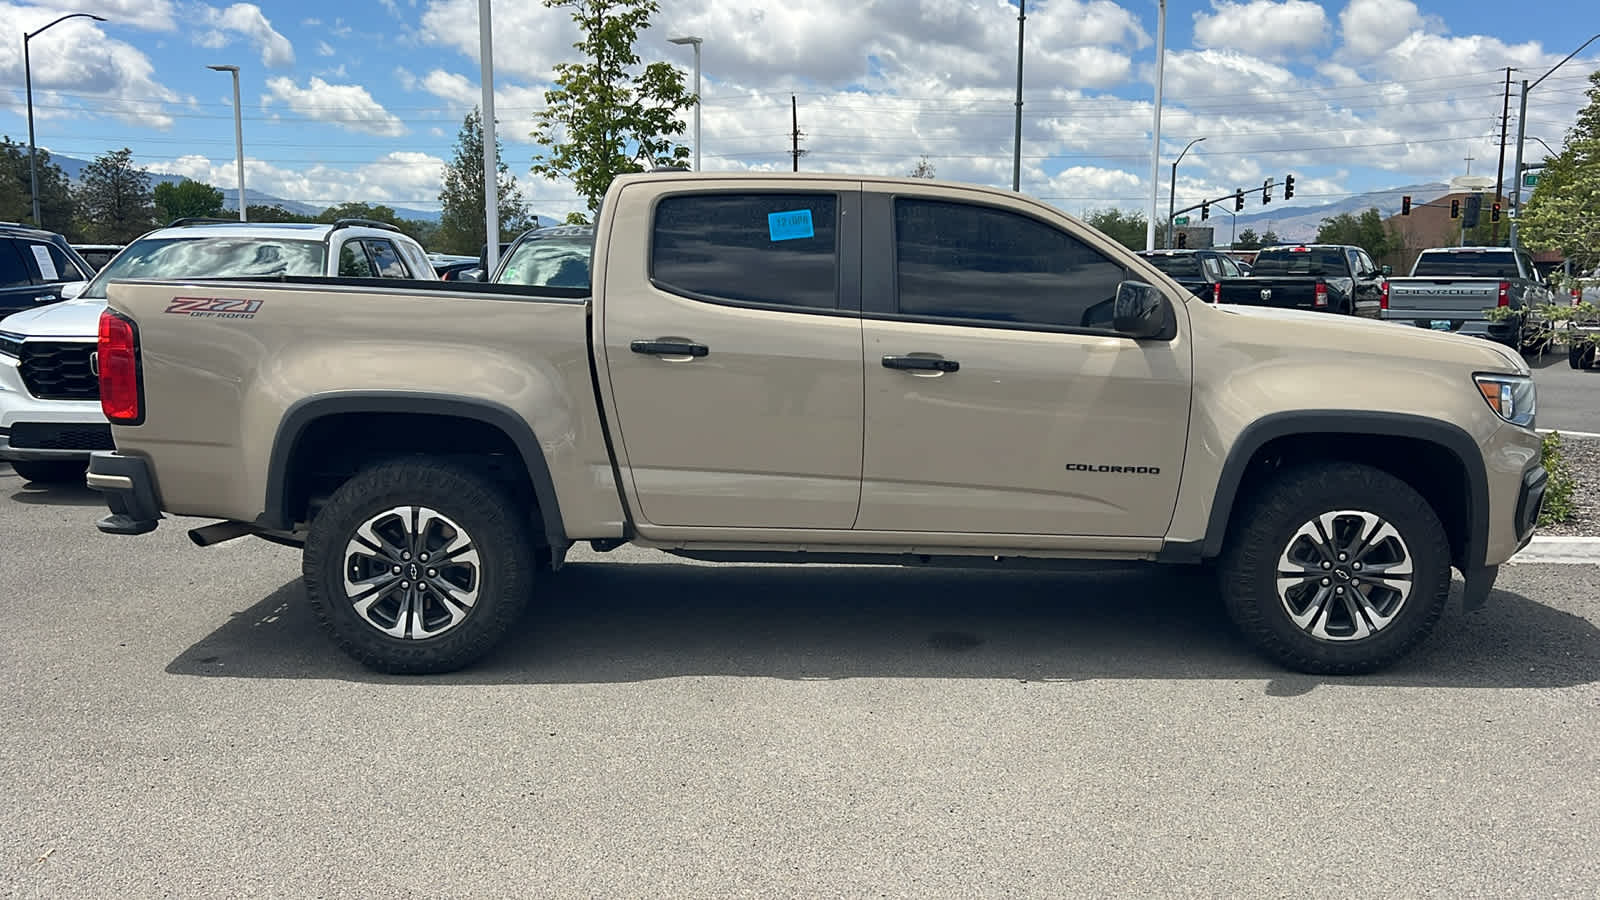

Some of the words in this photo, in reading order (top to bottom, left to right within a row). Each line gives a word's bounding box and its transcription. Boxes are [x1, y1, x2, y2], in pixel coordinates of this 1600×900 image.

[1395, 288, 1492, 296] CHEVROLET
[165, 296, 264, 314] Z71
[217, 312, 255, 320] ROAD
[1065, 463, 1160, 475] COLORADO
